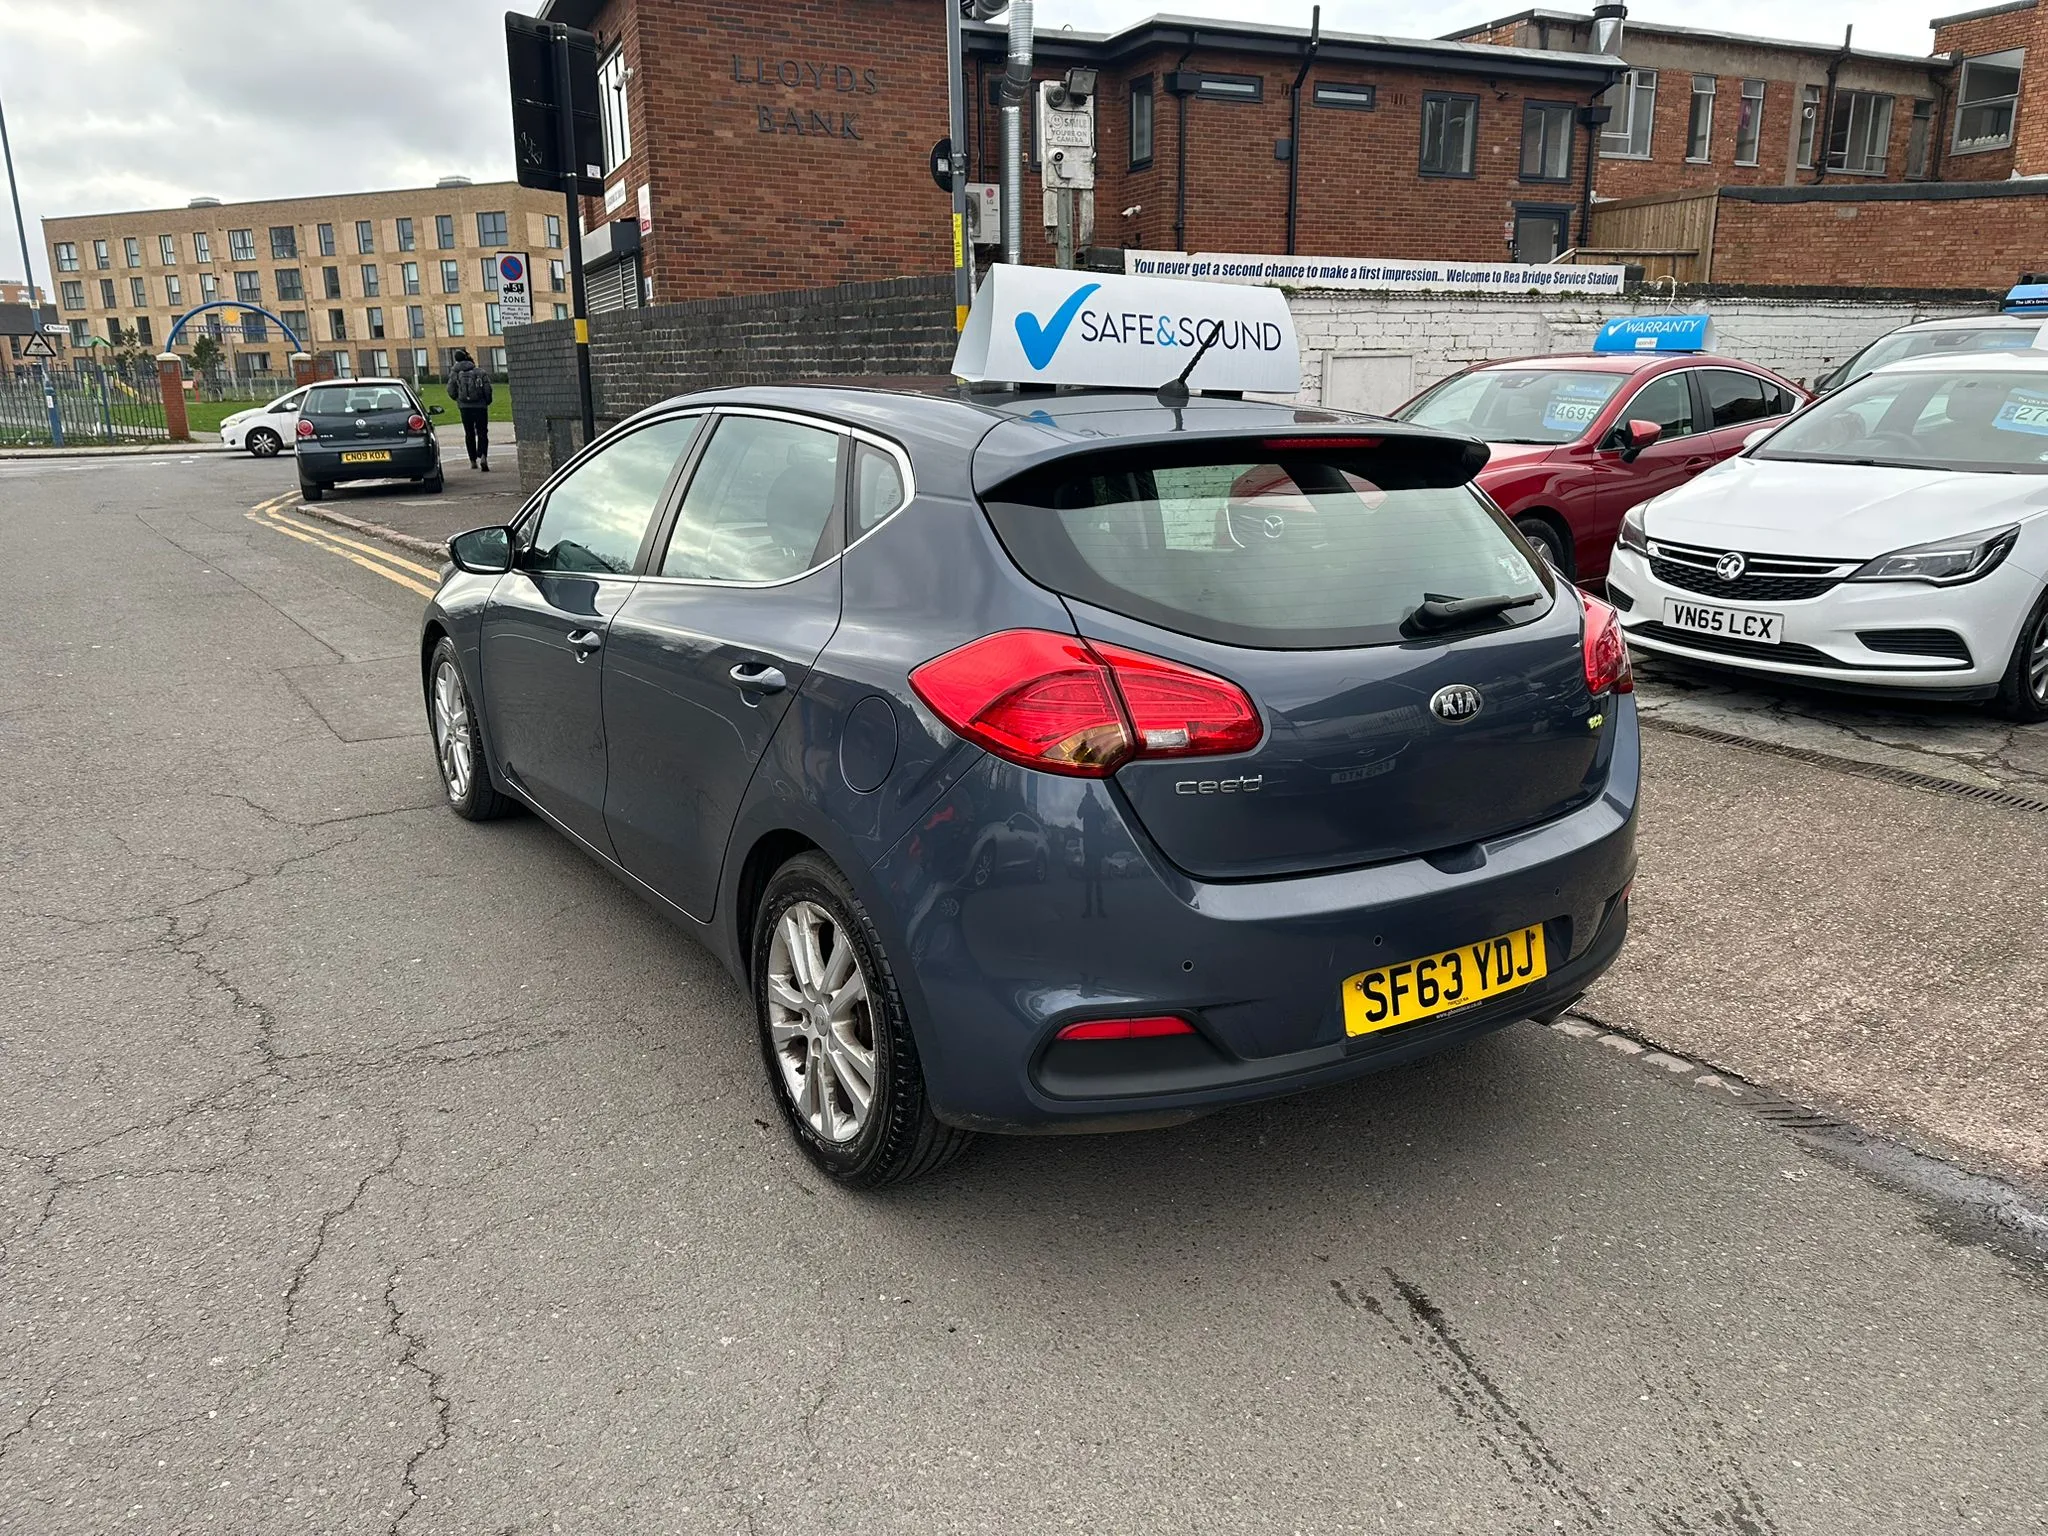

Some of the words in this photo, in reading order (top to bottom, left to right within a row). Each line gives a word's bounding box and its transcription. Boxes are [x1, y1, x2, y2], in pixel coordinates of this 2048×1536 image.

[732, 54, 879, 95] LLOYDS
[756, 104, 864, 140] BANK
[1134, 258, 1156, 274] You
[1156, 262, 1190, 276] never
[1191, 262, 1212, 277] get
[1213, 265, 1221, 276] a
[1221, 262, 1264, 278] second
[1264, 263, 1304, 278] chance
[1306, 264, 1319, 278] to
[1319, 265, 1349, 279] make
[1349, 268, 1357, 279] a
[1358, 265, 1381, 280] first
[1446, 269, 1491, 283] Welcome
[1491, 270, 1501, 283] to
[1502, 271, 1520, 283] Rea
[1521, 271, 1552, 286] Bridge
[1553, 271, 1587, 285] Service
[1587, 271, 1619, 286] Station
[1625, 319, 1700, 334] WARRANTY
[345, 453, 368, 461] CN09
[1674, 604, 1724, 631] VN65
[1728, 613, 1773, 639] LCX
[1440, 691, 1477, 717] KIA
[1175, 775, 1263, 795] cee'd
[1362, 952, 1464, 1024] SF63
[1472, 929, 1534, 991] YDJ
